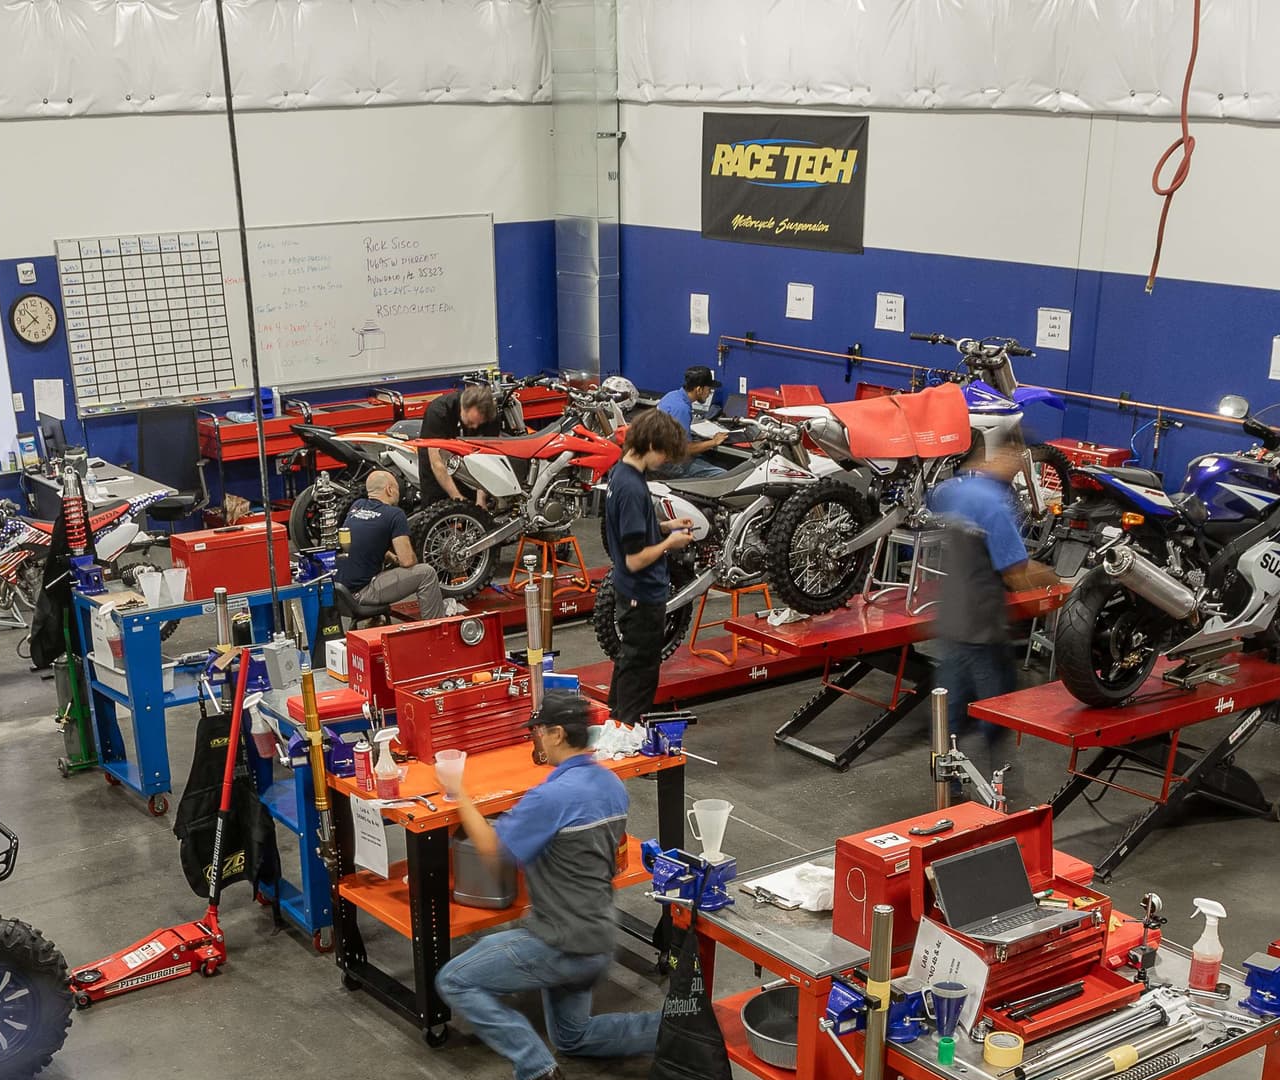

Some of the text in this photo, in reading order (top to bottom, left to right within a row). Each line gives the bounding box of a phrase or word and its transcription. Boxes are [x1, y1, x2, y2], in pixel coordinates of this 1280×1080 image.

[711, 144, 858, 184] RACE TECH
[731, 214, 830, 234] Motorcycle Suspension
[30, 299, 36, 307] 12
[45, 307, 50, 315] 2
[91, 510, 120, 525] ONDA
[873, 835, 900, 846] A-6
[921, 955, 929, 969] LAB
